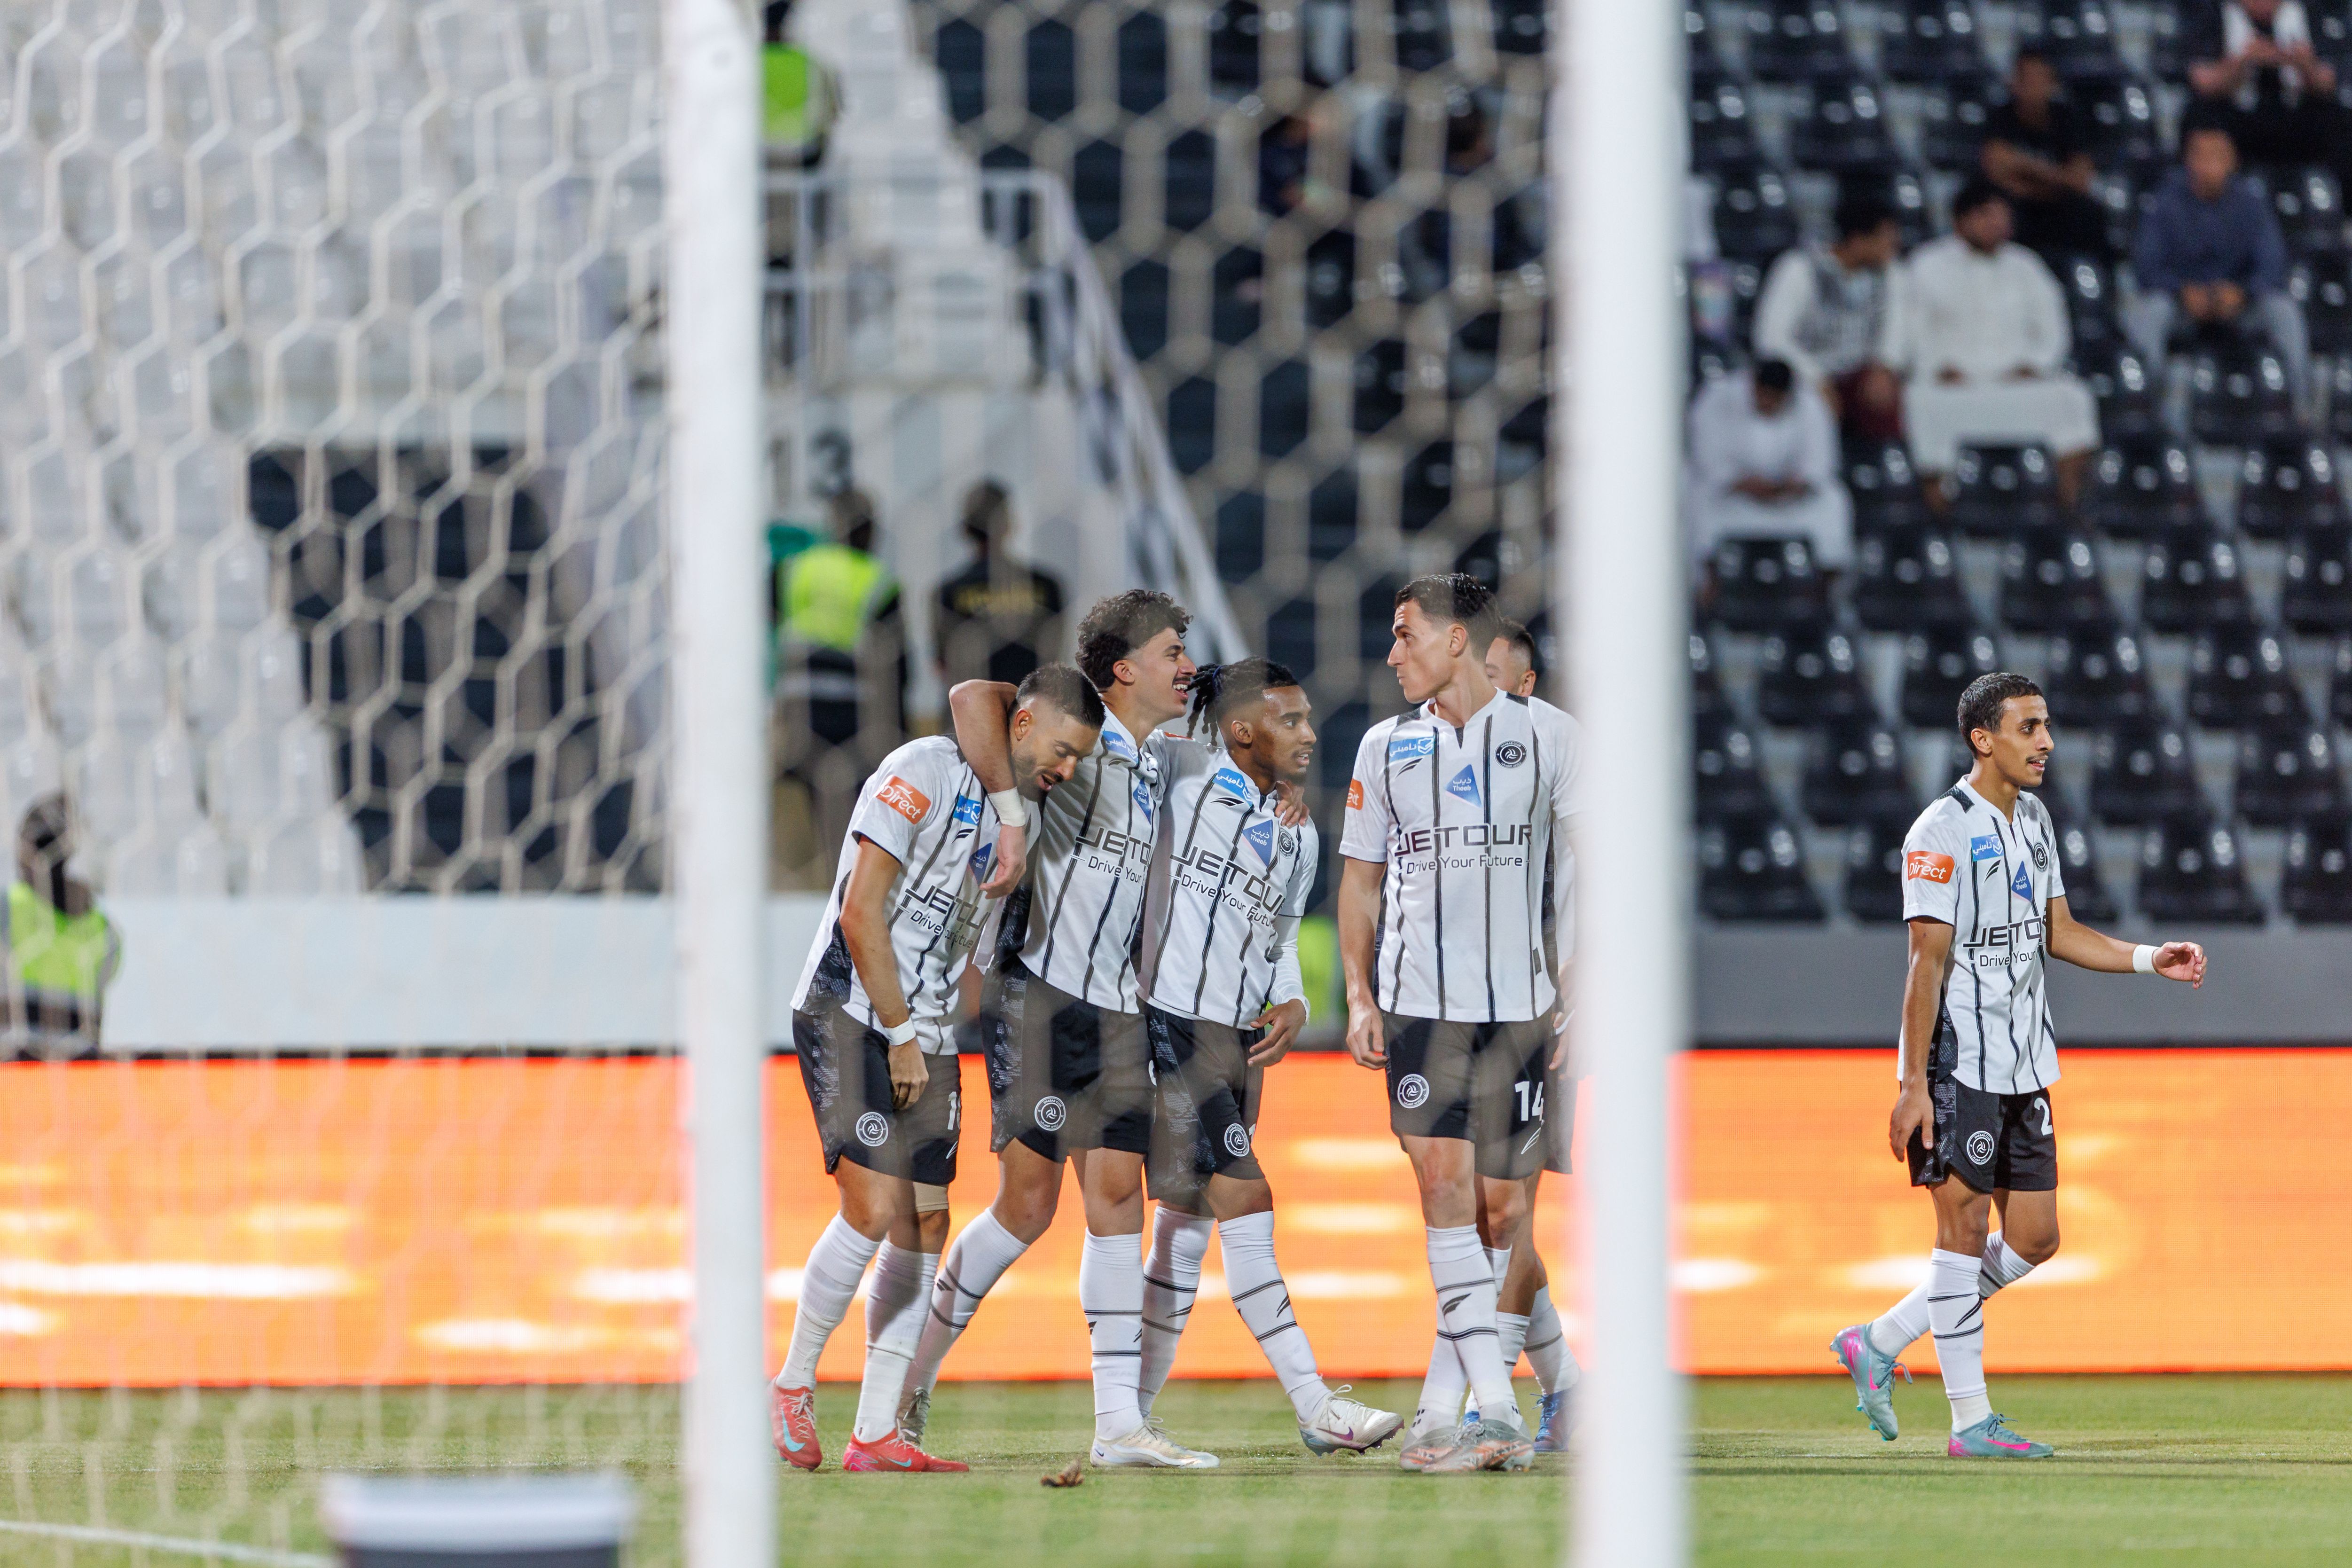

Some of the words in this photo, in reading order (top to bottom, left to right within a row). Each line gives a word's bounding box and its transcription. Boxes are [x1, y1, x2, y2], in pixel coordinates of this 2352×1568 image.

[1216, 775, 1244, 788] تأميني
[880, 784, 921, 819] Direct
[1075, 828, 1151, 866] JETO
[1250, 834, 1267, 846] Theeb
[1252, 829, 1270, 839] ذيب
[1395, 824, 1532, 857] JETOUR
[1973, 840, 1992, 855] تأميني
[1088, 855, 1121, 877] Drive
[1126, 866, 1142, 884] Your
[1407, 861, 1436, 874] Drive
[1440, 856, 1475, 869] Your
[1480, 854, 1523, 867] Future
[1909, 862, 1947, 879] Direct
[905, 885, 991, 930] JETOU
[1181, 874, 1216, 898] Drive
[1222, 889, 1246, 912] Your
[1247, 906, 1271, 928] Futu
[910, 910, 942, 934] Drive
[1963, 917, 2042, 948] JETO
[1980, 955, 2010, 967] Drive
[1515, 1081, 1544, 1121] 14
